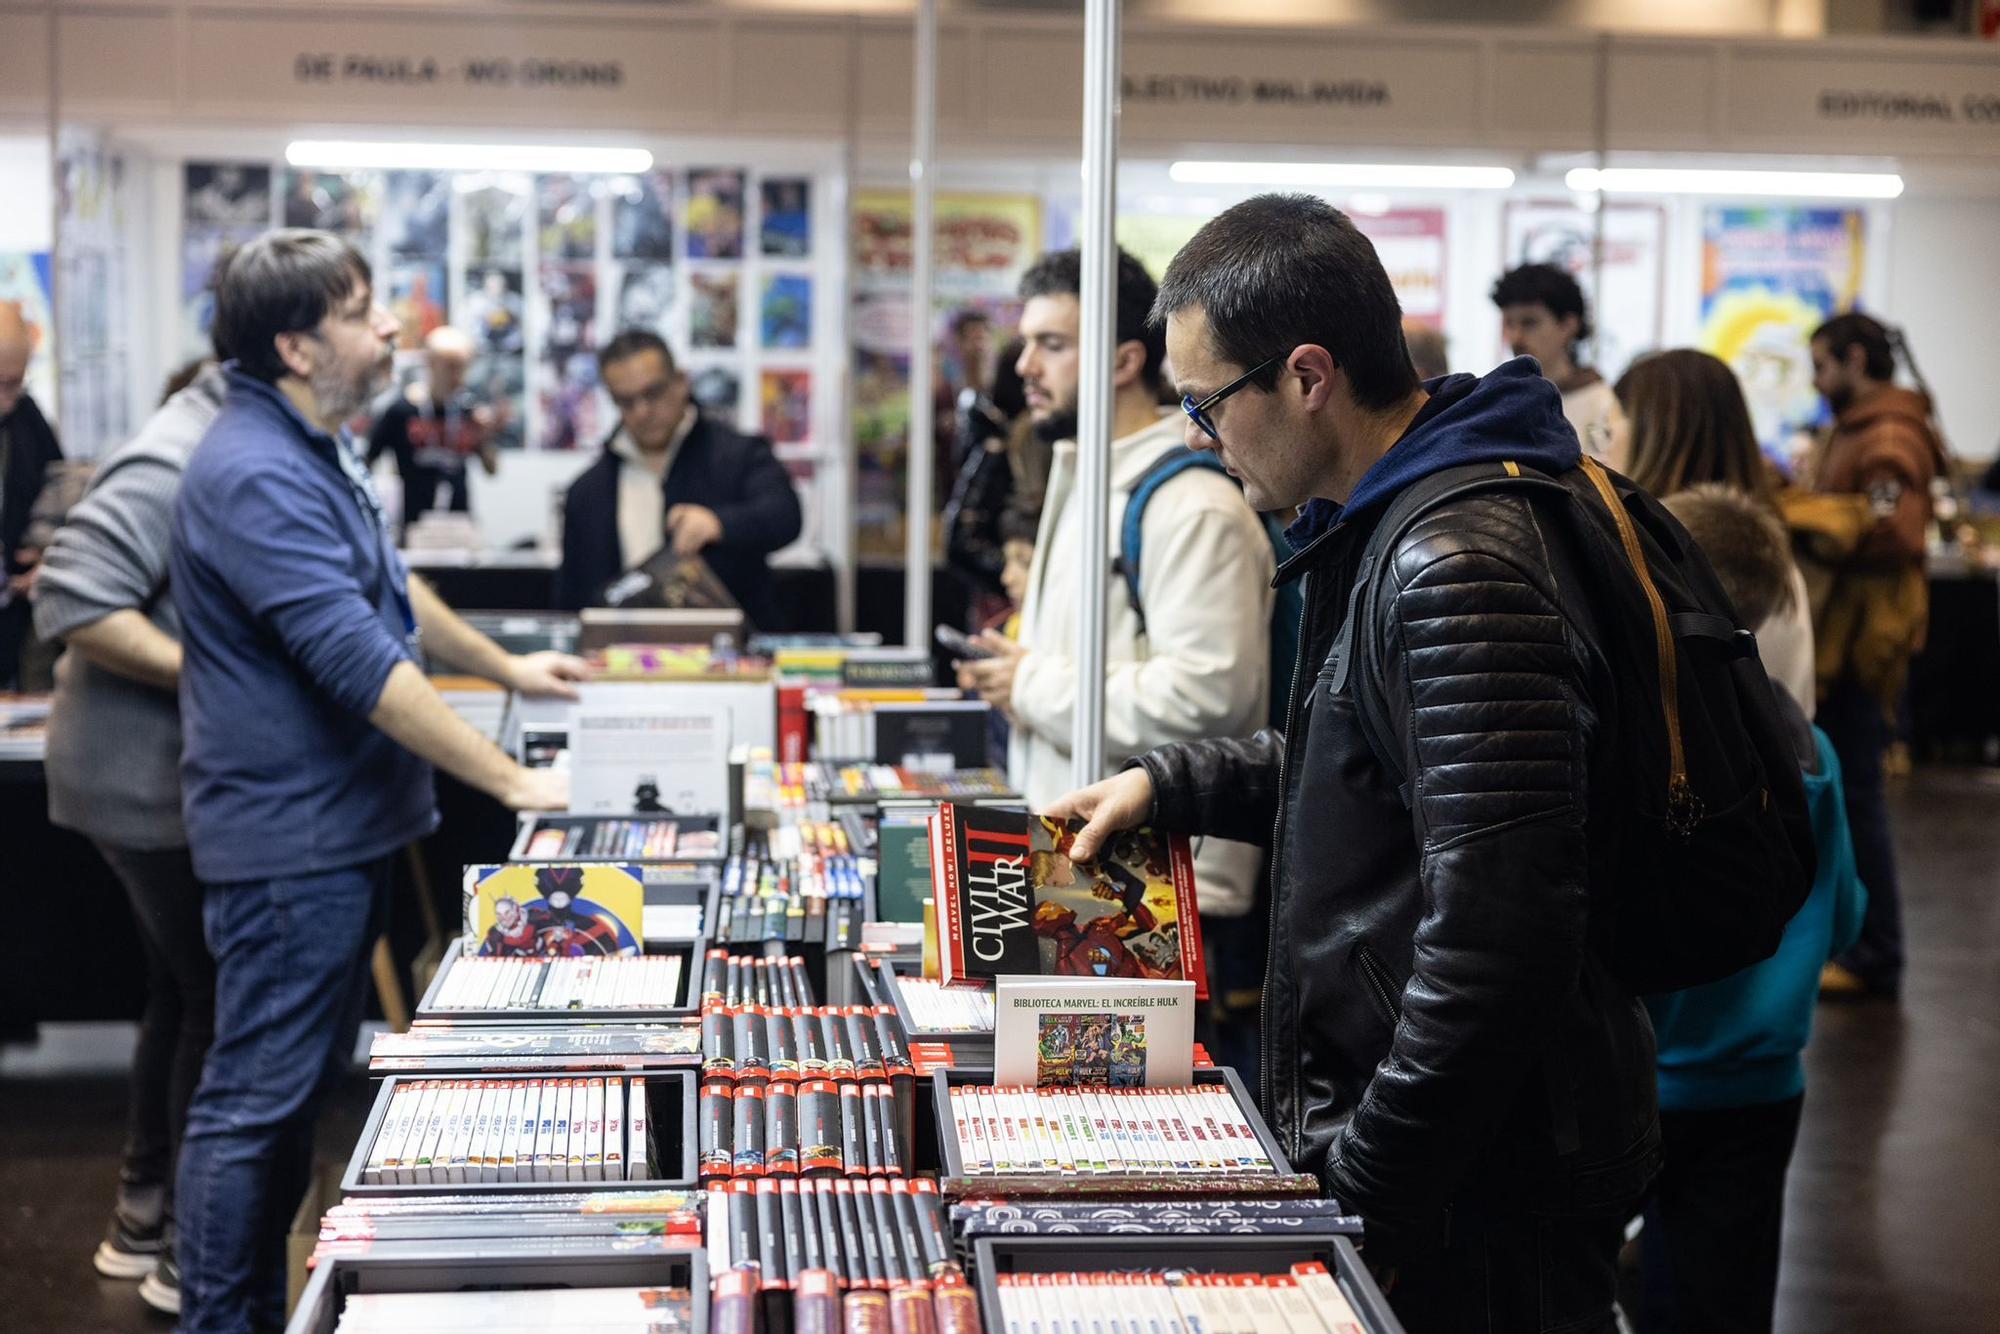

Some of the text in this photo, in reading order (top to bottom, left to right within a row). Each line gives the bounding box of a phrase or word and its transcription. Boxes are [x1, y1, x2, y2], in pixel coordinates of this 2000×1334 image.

[1818, 89, 1952, 120] EDITORIAL
[943, 807, 960, 941] MARVEL NOW! DELUXE
[968, 868, 1005, 961] CIVIL
[994, 853, 1030, 936] WAR
[1013, 996, 1178, 1008] BIBLIOTECA MARVEL: EL INCREÍBLE HULK
